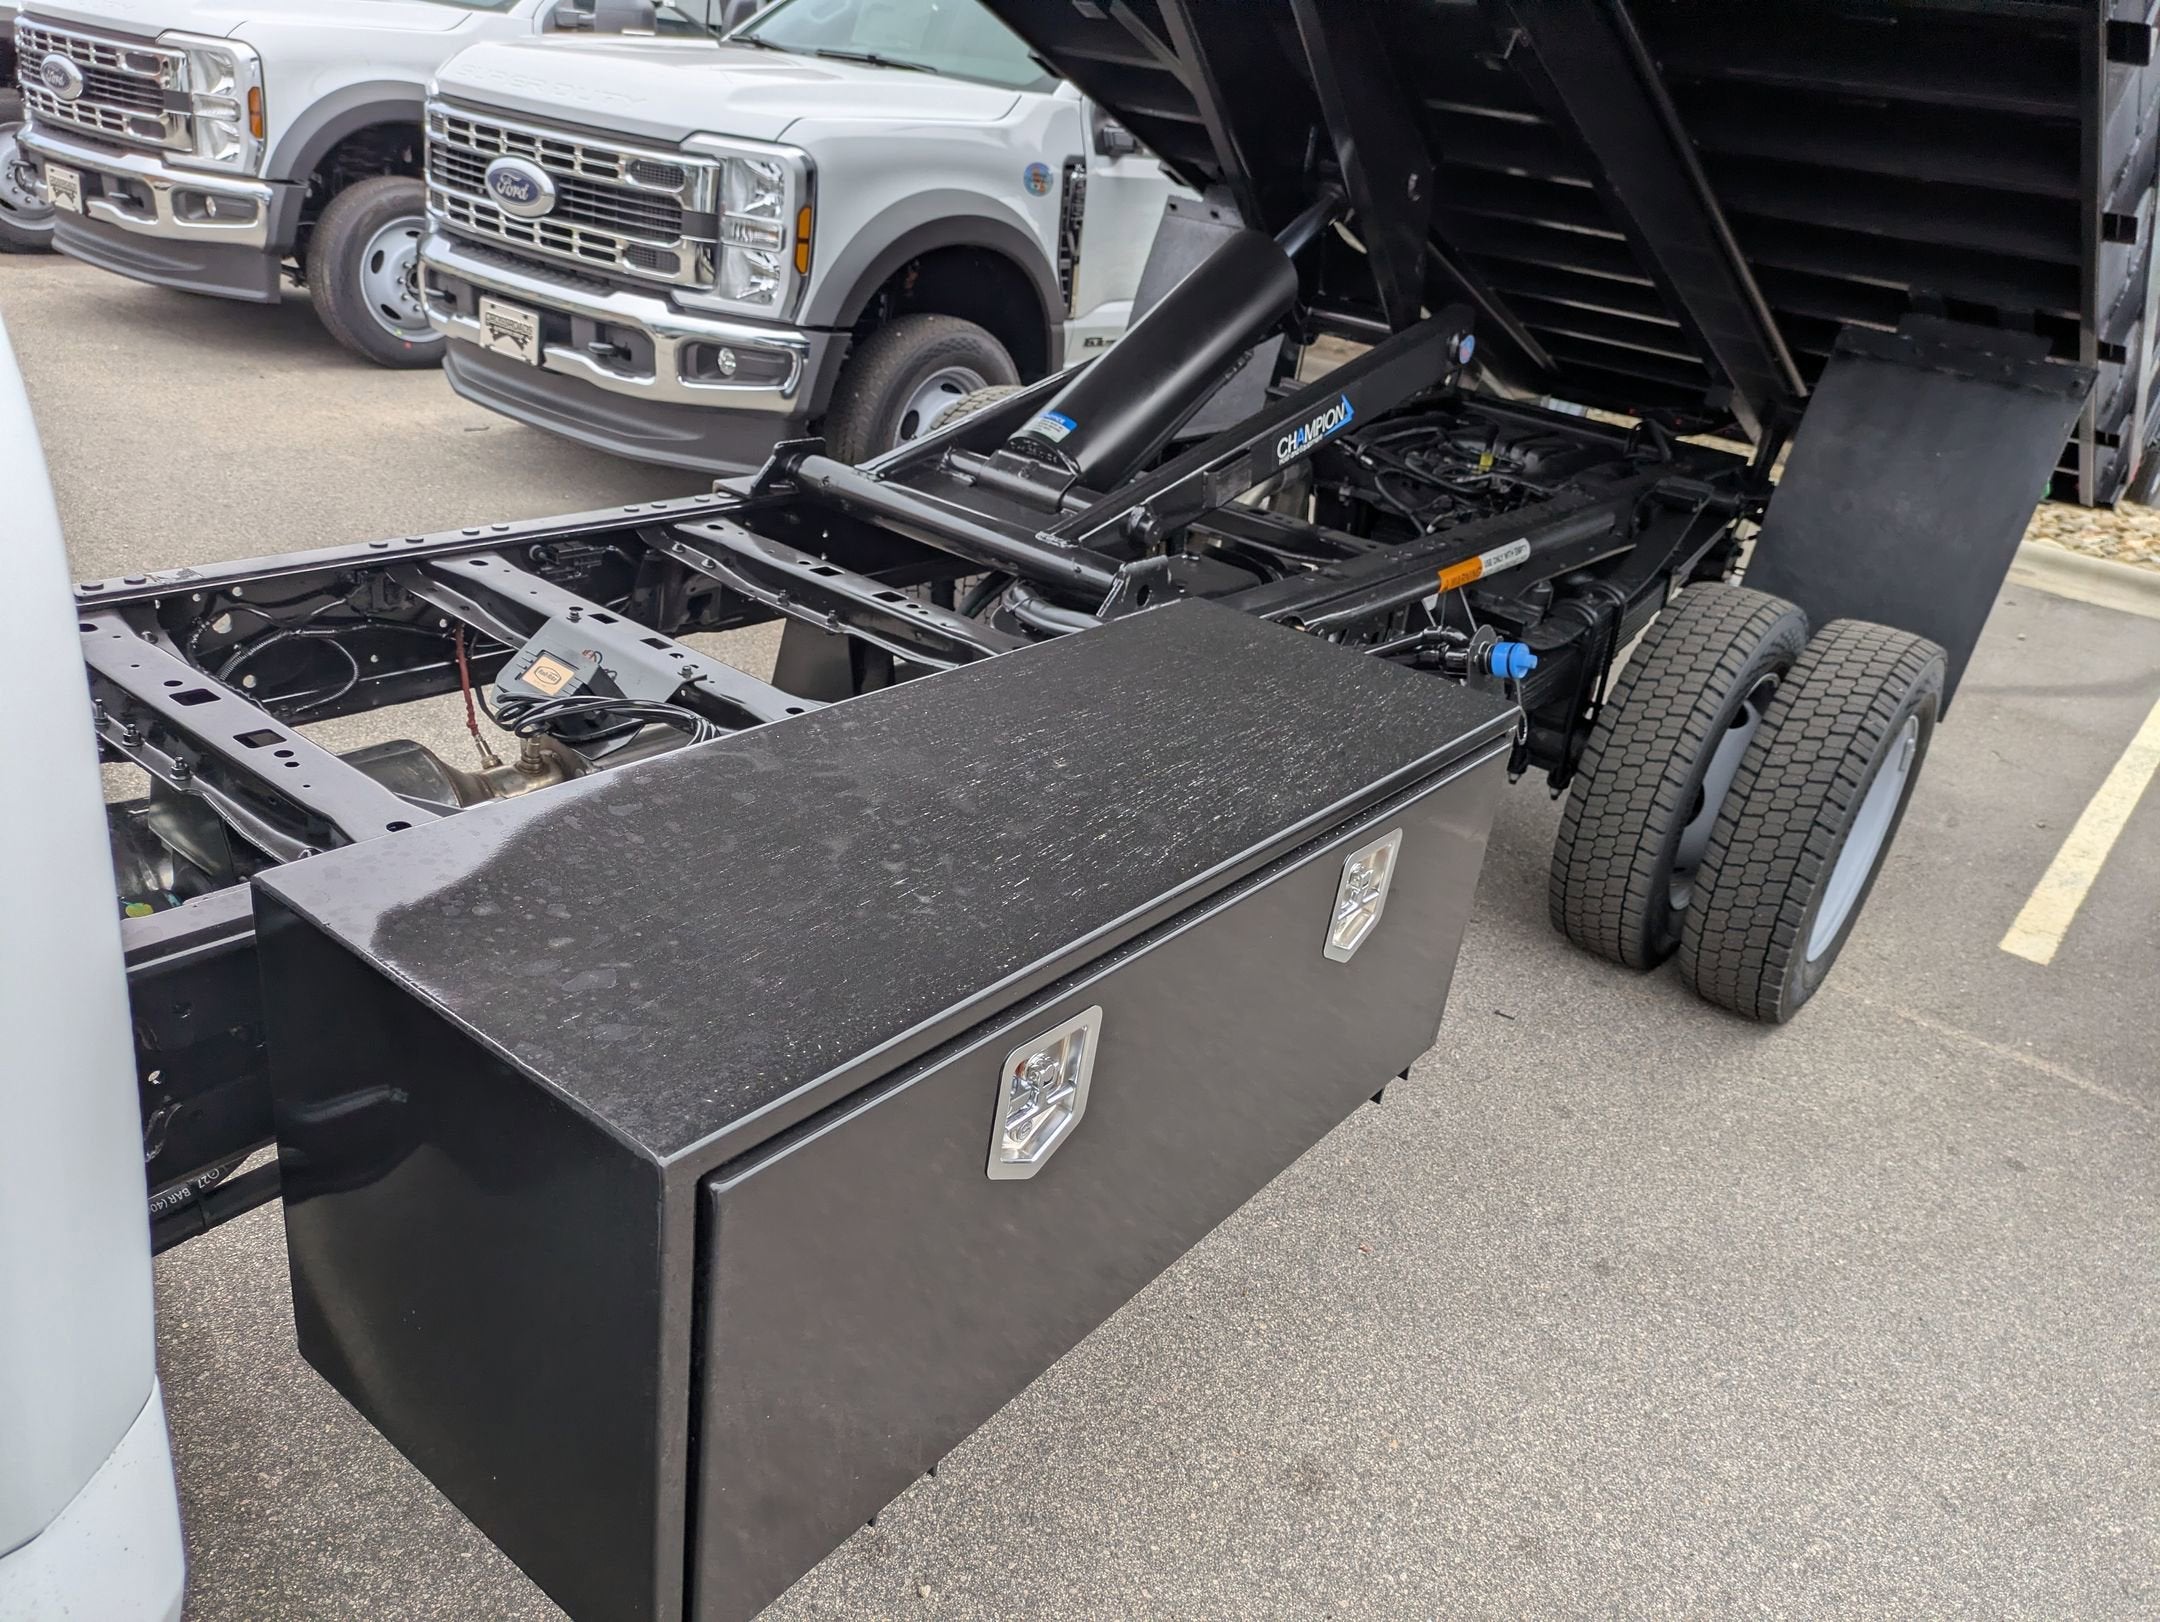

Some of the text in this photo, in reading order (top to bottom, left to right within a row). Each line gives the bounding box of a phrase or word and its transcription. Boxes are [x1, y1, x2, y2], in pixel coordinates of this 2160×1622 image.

[46, 67, 66, 87] Ford
[497, 173, 530, 201] Ford
[1277, 402, 1345, 459] CHAMPION
[167, 1187, 192, 1204] BAR
